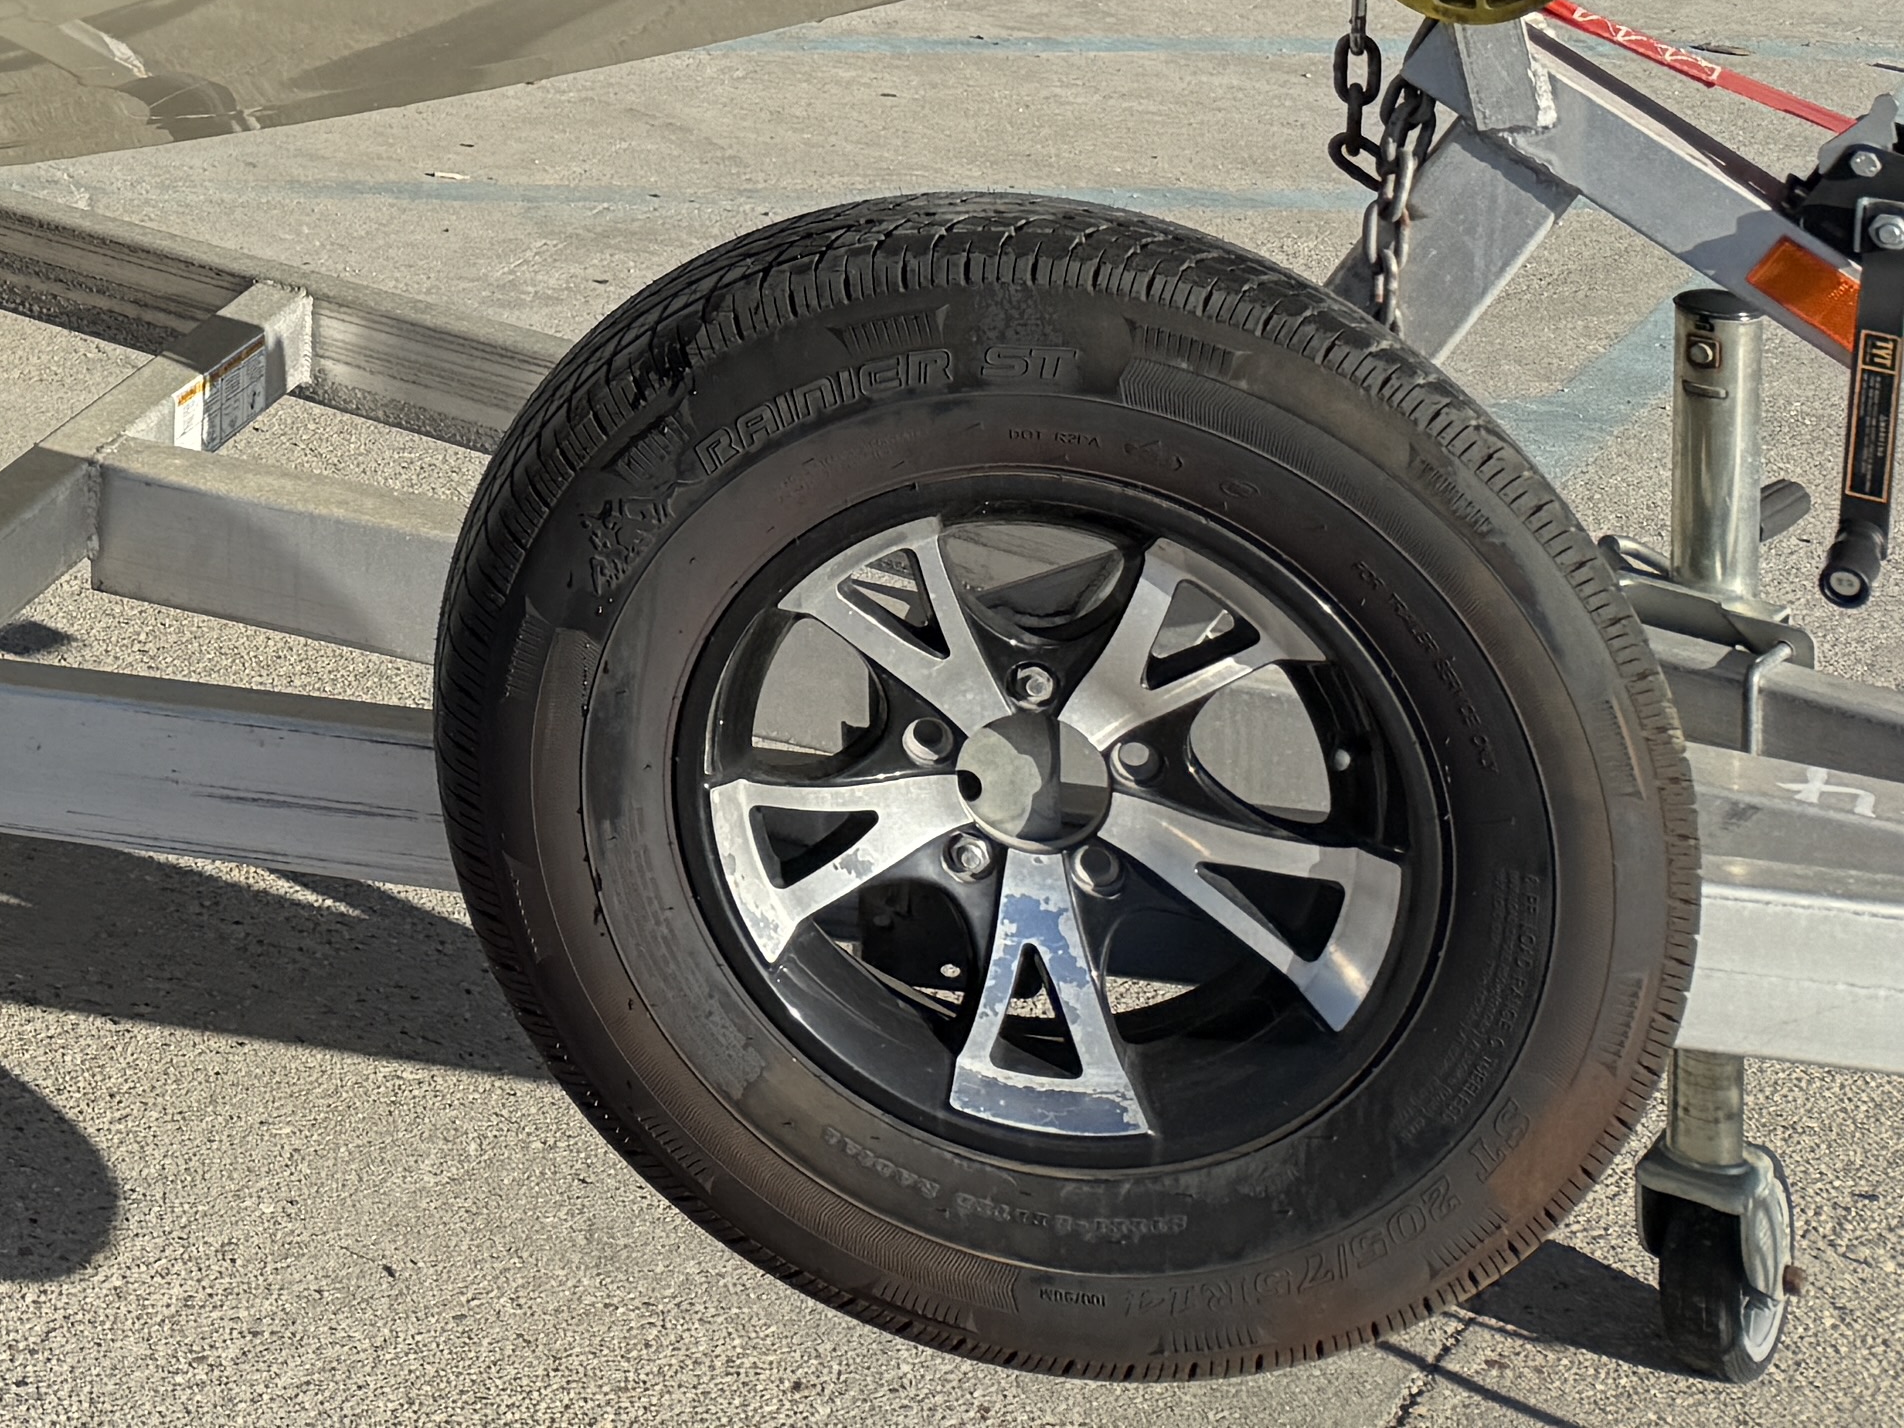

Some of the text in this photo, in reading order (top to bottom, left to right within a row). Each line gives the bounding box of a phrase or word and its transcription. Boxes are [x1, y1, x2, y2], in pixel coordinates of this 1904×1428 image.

[692, 347, 954, 476] RAINIER
[978, 345, 1082, 381] ST
[1007, 427, 1042, 441] DOT
